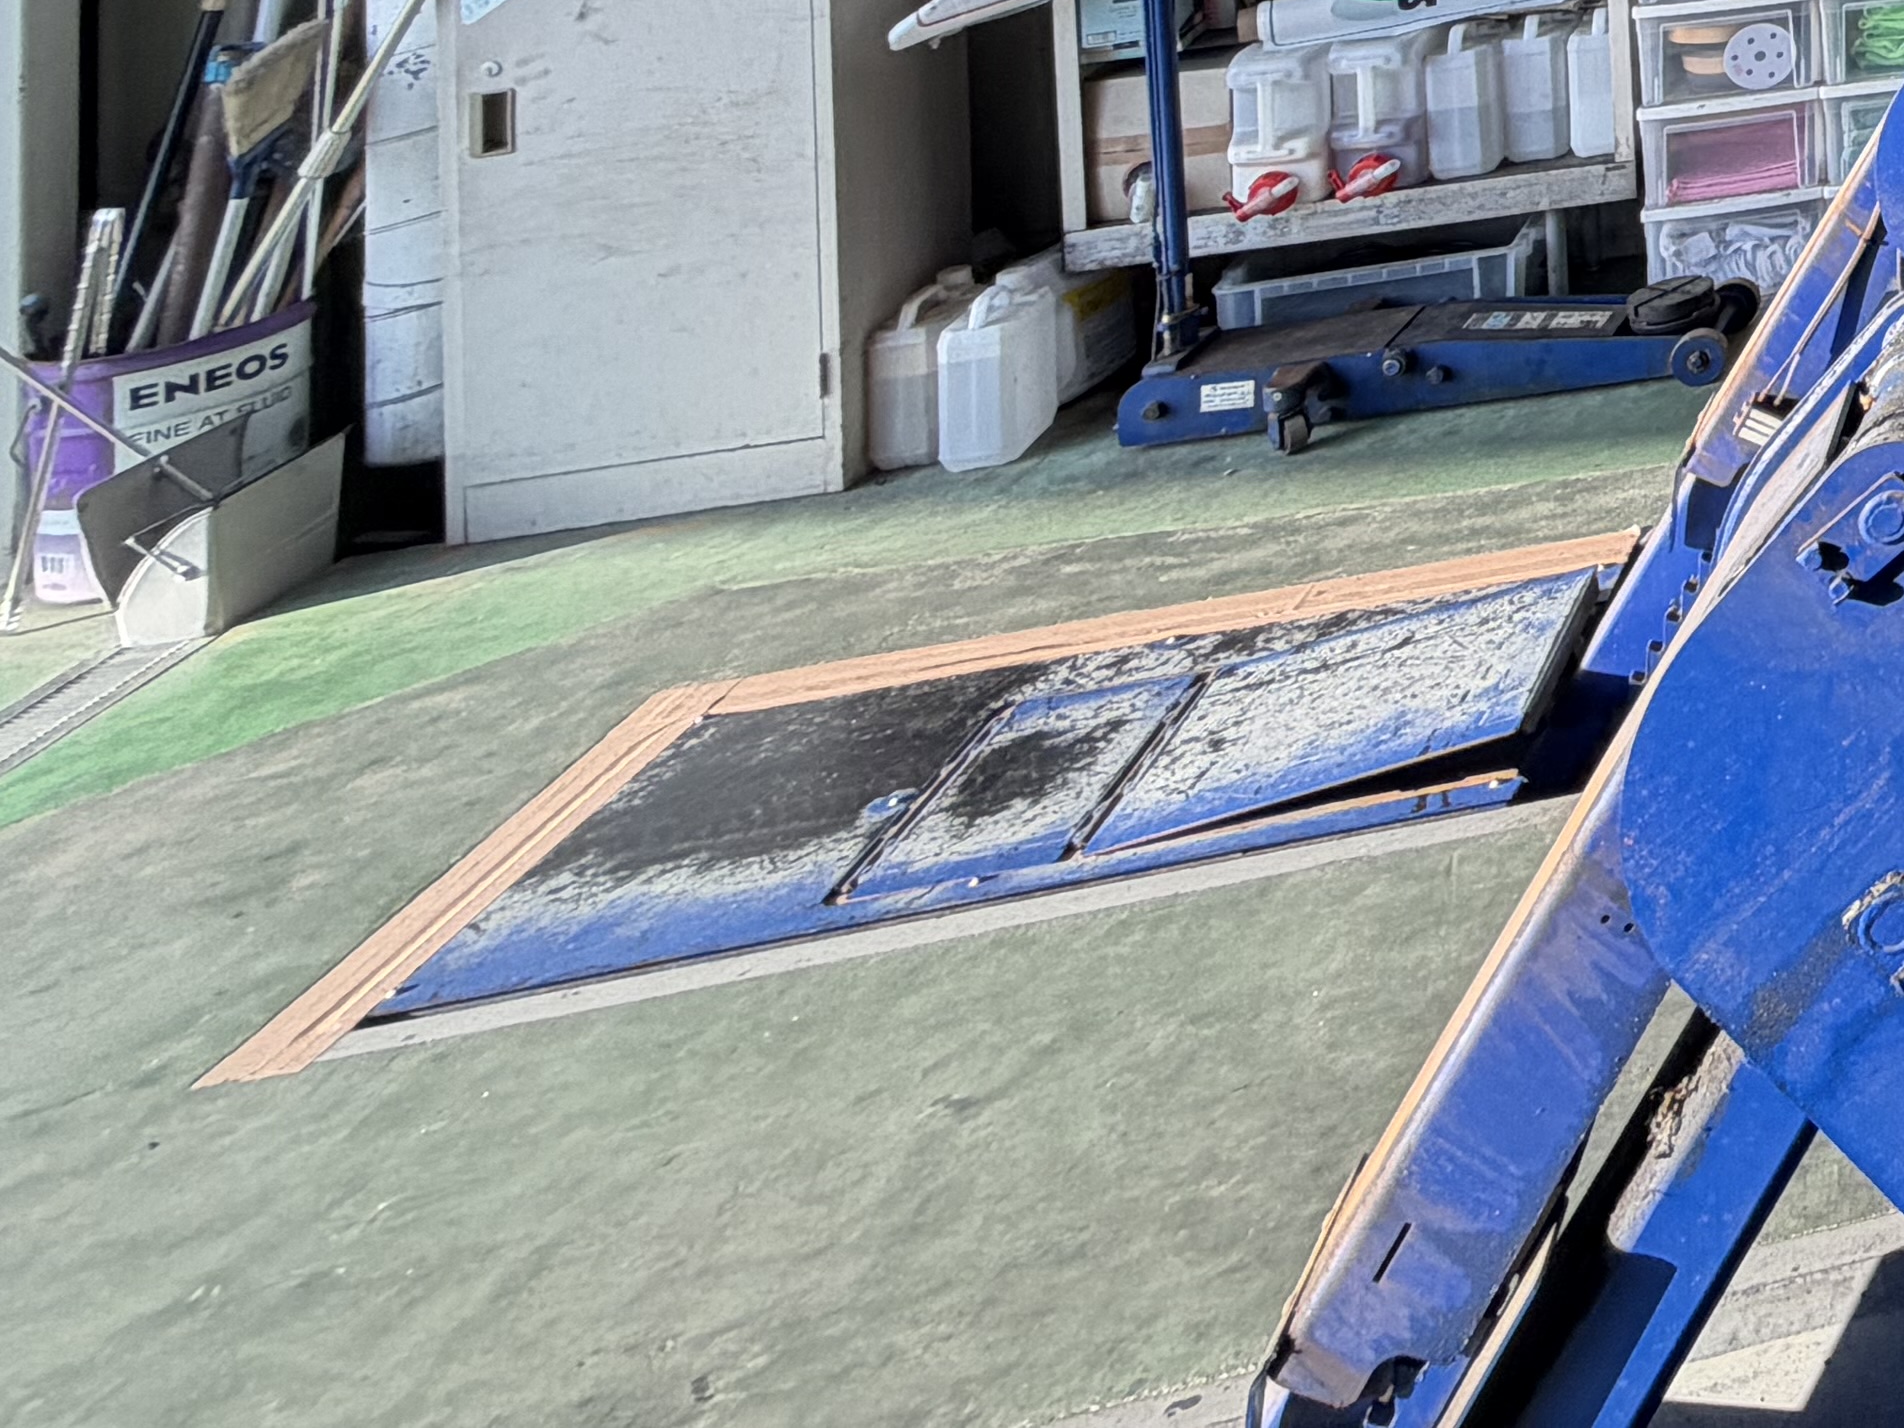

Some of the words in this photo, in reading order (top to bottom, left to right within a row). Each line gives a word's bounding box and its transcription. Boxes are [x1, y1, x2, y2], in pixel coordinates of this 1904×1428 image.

[129, 343, 289, 412] ENEOS
[128, 420, 192, 445] FINE
[198, 409, 230, 432] AT
